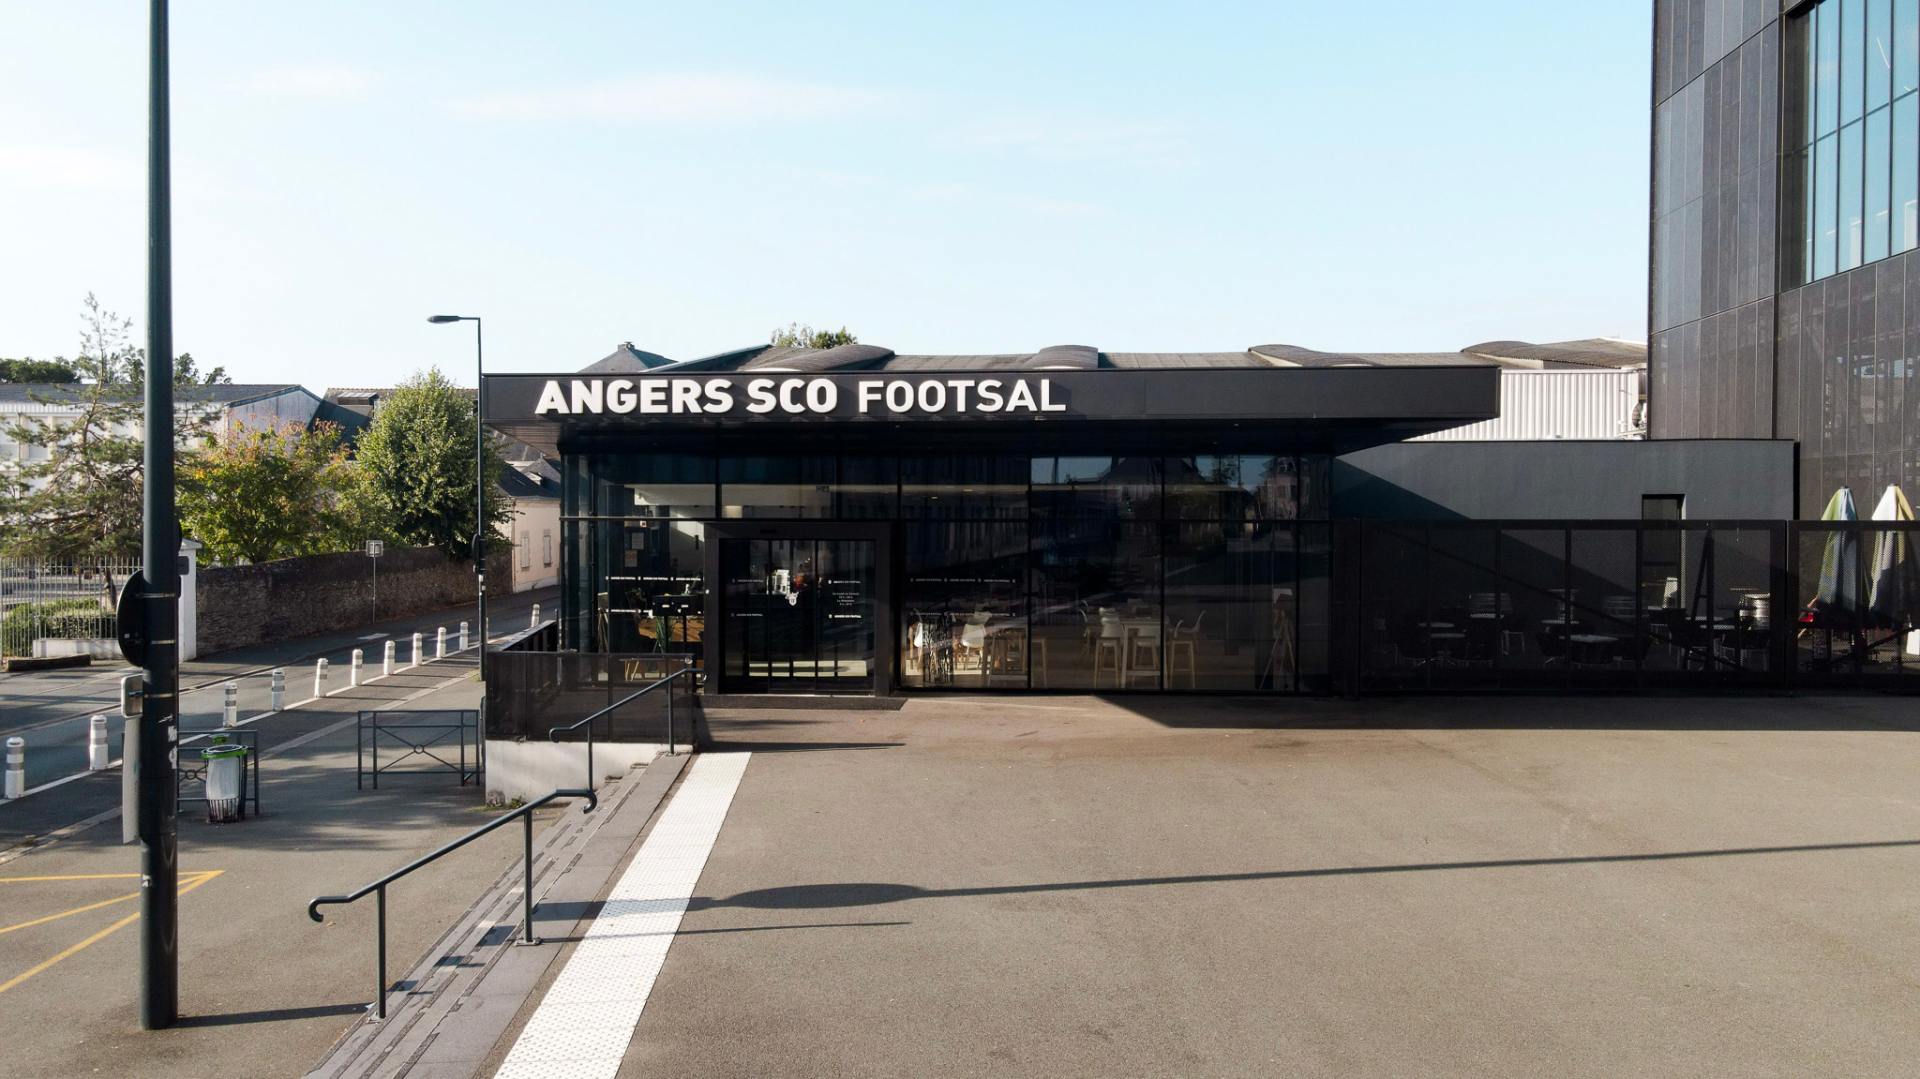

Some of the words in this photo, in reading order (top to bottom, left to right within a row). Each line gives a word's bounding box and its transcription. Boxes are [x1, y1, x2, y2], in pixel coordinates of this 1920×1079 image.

[534, 378, 734, 415] ANGERS
[746, 378, 837, 414] SCO
[858, 379, 1067, 413] FOOTSAL
